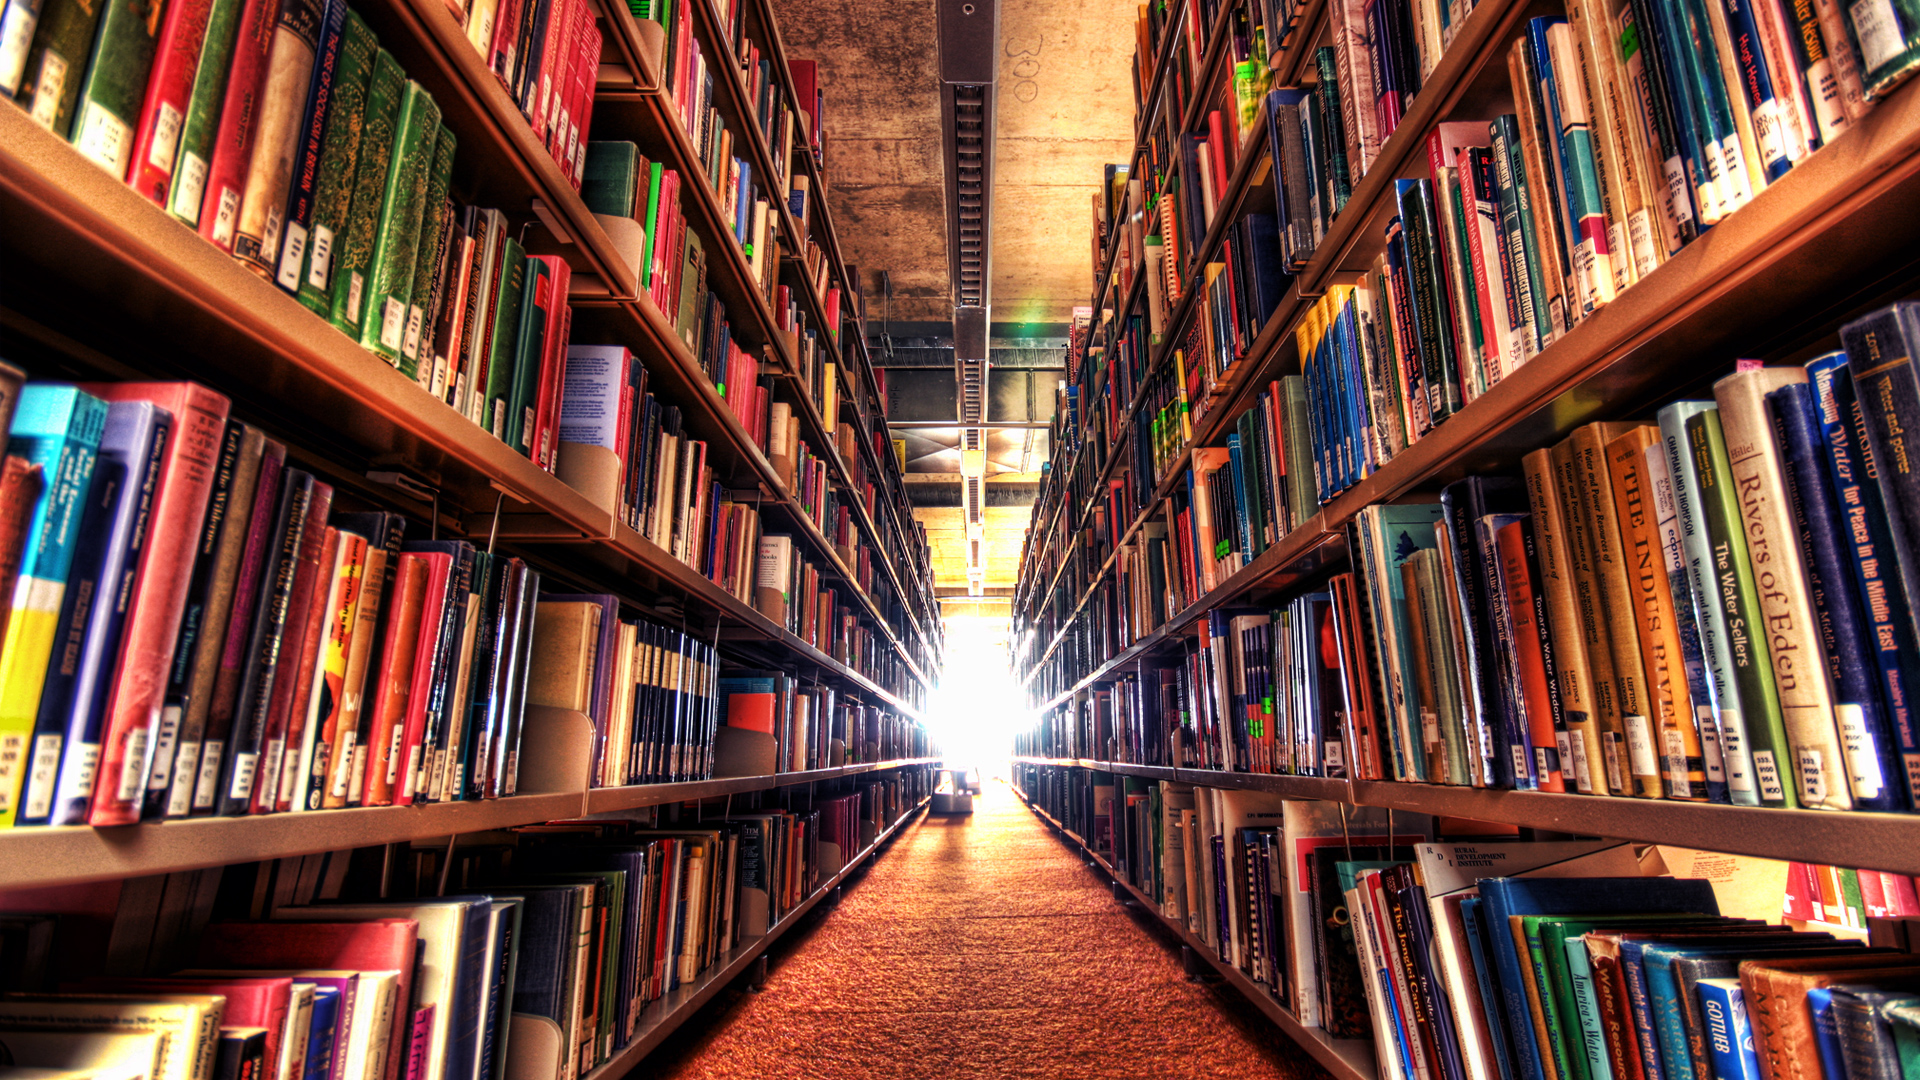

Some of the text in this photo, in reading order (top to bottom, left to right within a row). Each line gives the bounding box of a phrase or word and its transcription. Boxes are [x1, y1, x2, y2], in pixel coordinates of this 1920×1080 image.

[323, 50, 335, 73] RISE
[327, 31, 339, 53] THE
[1368, 11, 1382, 96] WATER RESOURCES
[1740, 33, 1753, 66] Hugh
[321, 71, 331, 88] OF
[1336, 26, 1356, 147] WATER IN CRISIS
[1581, 62, 1592, 101] MANAGEMENT
[310, 86, 328, 140] SOCIALISM
[1590, 112, 1598, 132] ARID
[309, 138, 319, 153] IN
[1592, 131, 1601, 150] LANDS
[301, 151, 317, 193] BRITAIN
[1513, 153, 1529, 210] WATSAN 2000
[1597, 158, 1608, 197] DEVELOPING
[1459, 160, 1474, 225] RAINWATER
[1468, 223, 1485, 291] HARVESTING
[1510, 230, 1522, 252] WATER
[1515, 251, 1529, 292] RESOURCES
[1878, 375, 1894, 411] Water
[1886, 410, 1904, 437] and
[72, 446, 88, 486] Social
[83, 456, 96, 479] The
[1730, 443, 1755, 460] Hillel
[58, 455, 75, 505] and the
[203, 428, 241, 554] Left in the Wilderness
[1667, 435, 1695, 537] CHAPMAN AND THOMPSON
[56, 488, 78, 546] Economy
[1565, 462, 1590, 573] Water and Power Resources of
[1584, 448, 1612, 564] Water and Power Resources of
[1815, 367, 1898, 652] Managing Water for Peace in the Middle East
[1526, 535, 1534, 557] IYER
[1534, 473, 1560, 580] Water and Power Resources of
[350, 538, 360, 559] David
[1456, 507, 1465, 546] WATER
[1461, 548, 1476, 613] RESOURCES
[1624, 465, 1662, 632] THE INDUS
[1740, 472, 1798, 692] Rivers of Eden
[1785, 461, 1841, 680] International Waters of the Middle East
[340, 614, 347, 624] in
[342, 597, 351, 614] Left
[1715, 542, 1749, 668] The Water Sellers
[337, 622, 347, 648] Britain
[1496, 616, 1506, 641] World
[1692, 557, 1724, 699] Water the Ganges Valley
[1536, 596, 1561, 724] Towards Water Wisdom
[1570, 670, 1580, 704] LIEFTINCK
[1603, 681, 1614, 718] LIEFTINCK
[1627, 676, 1638, 715] LIEFTINCK
[1756, 756, 1771, 764] 333.
[1427, 846, 1434, 855] R
[1437, 852, 1444, 861] D
[1352, 912, 1362, 945] Wasting
[1368, 911, 1379, 951] Techniques
[1393, 904, 1403, 930] The
[1398, 933, 1416, 981] Jonglei
[1410, 982, 1425, 1023] Canal
[1395, 957, 1405, 992] WATER
[488, 984, 499, 1023] JEAN
[1420, 974, 1434, 1014] The Nile
[1535, 962, 1554, 1027] Interbasin
[1600, 968, 1615, 1015] Water
[1573, 973, 1601, 1063] America's Water
[1627, 961, 1659, 1068] drought and water
[1706, 1000, 1730, 1054] GOTTLIEB
